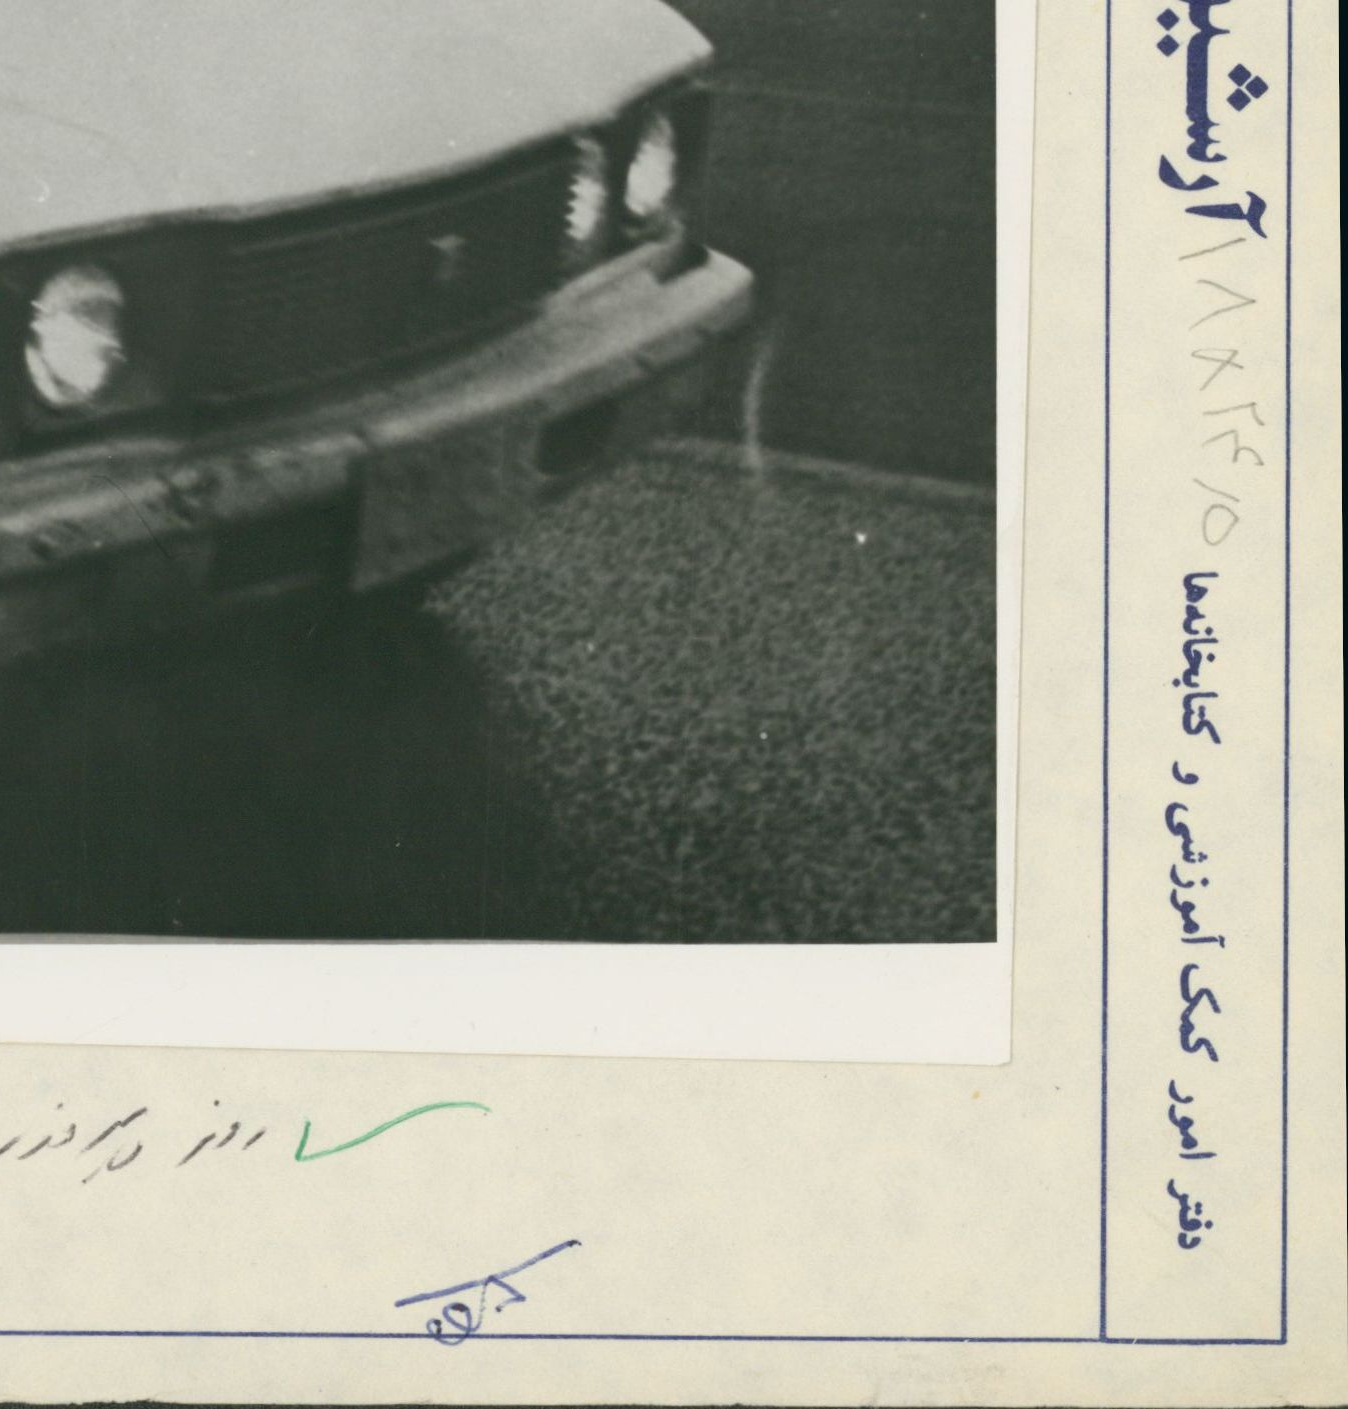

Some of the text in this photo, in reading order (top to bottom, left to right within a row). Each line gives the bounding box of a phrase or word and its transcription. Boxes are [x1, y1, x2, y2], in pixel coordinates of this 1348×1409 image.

[1172, 761, 1199, 785] و
[1165, 802, 1225, 948] آموزشی
[1179, 963, 1221, 1062] کمک
[1168, 1080, 1217, 1160] امور
[1167, 1179, 1203, 1250] دفتر
